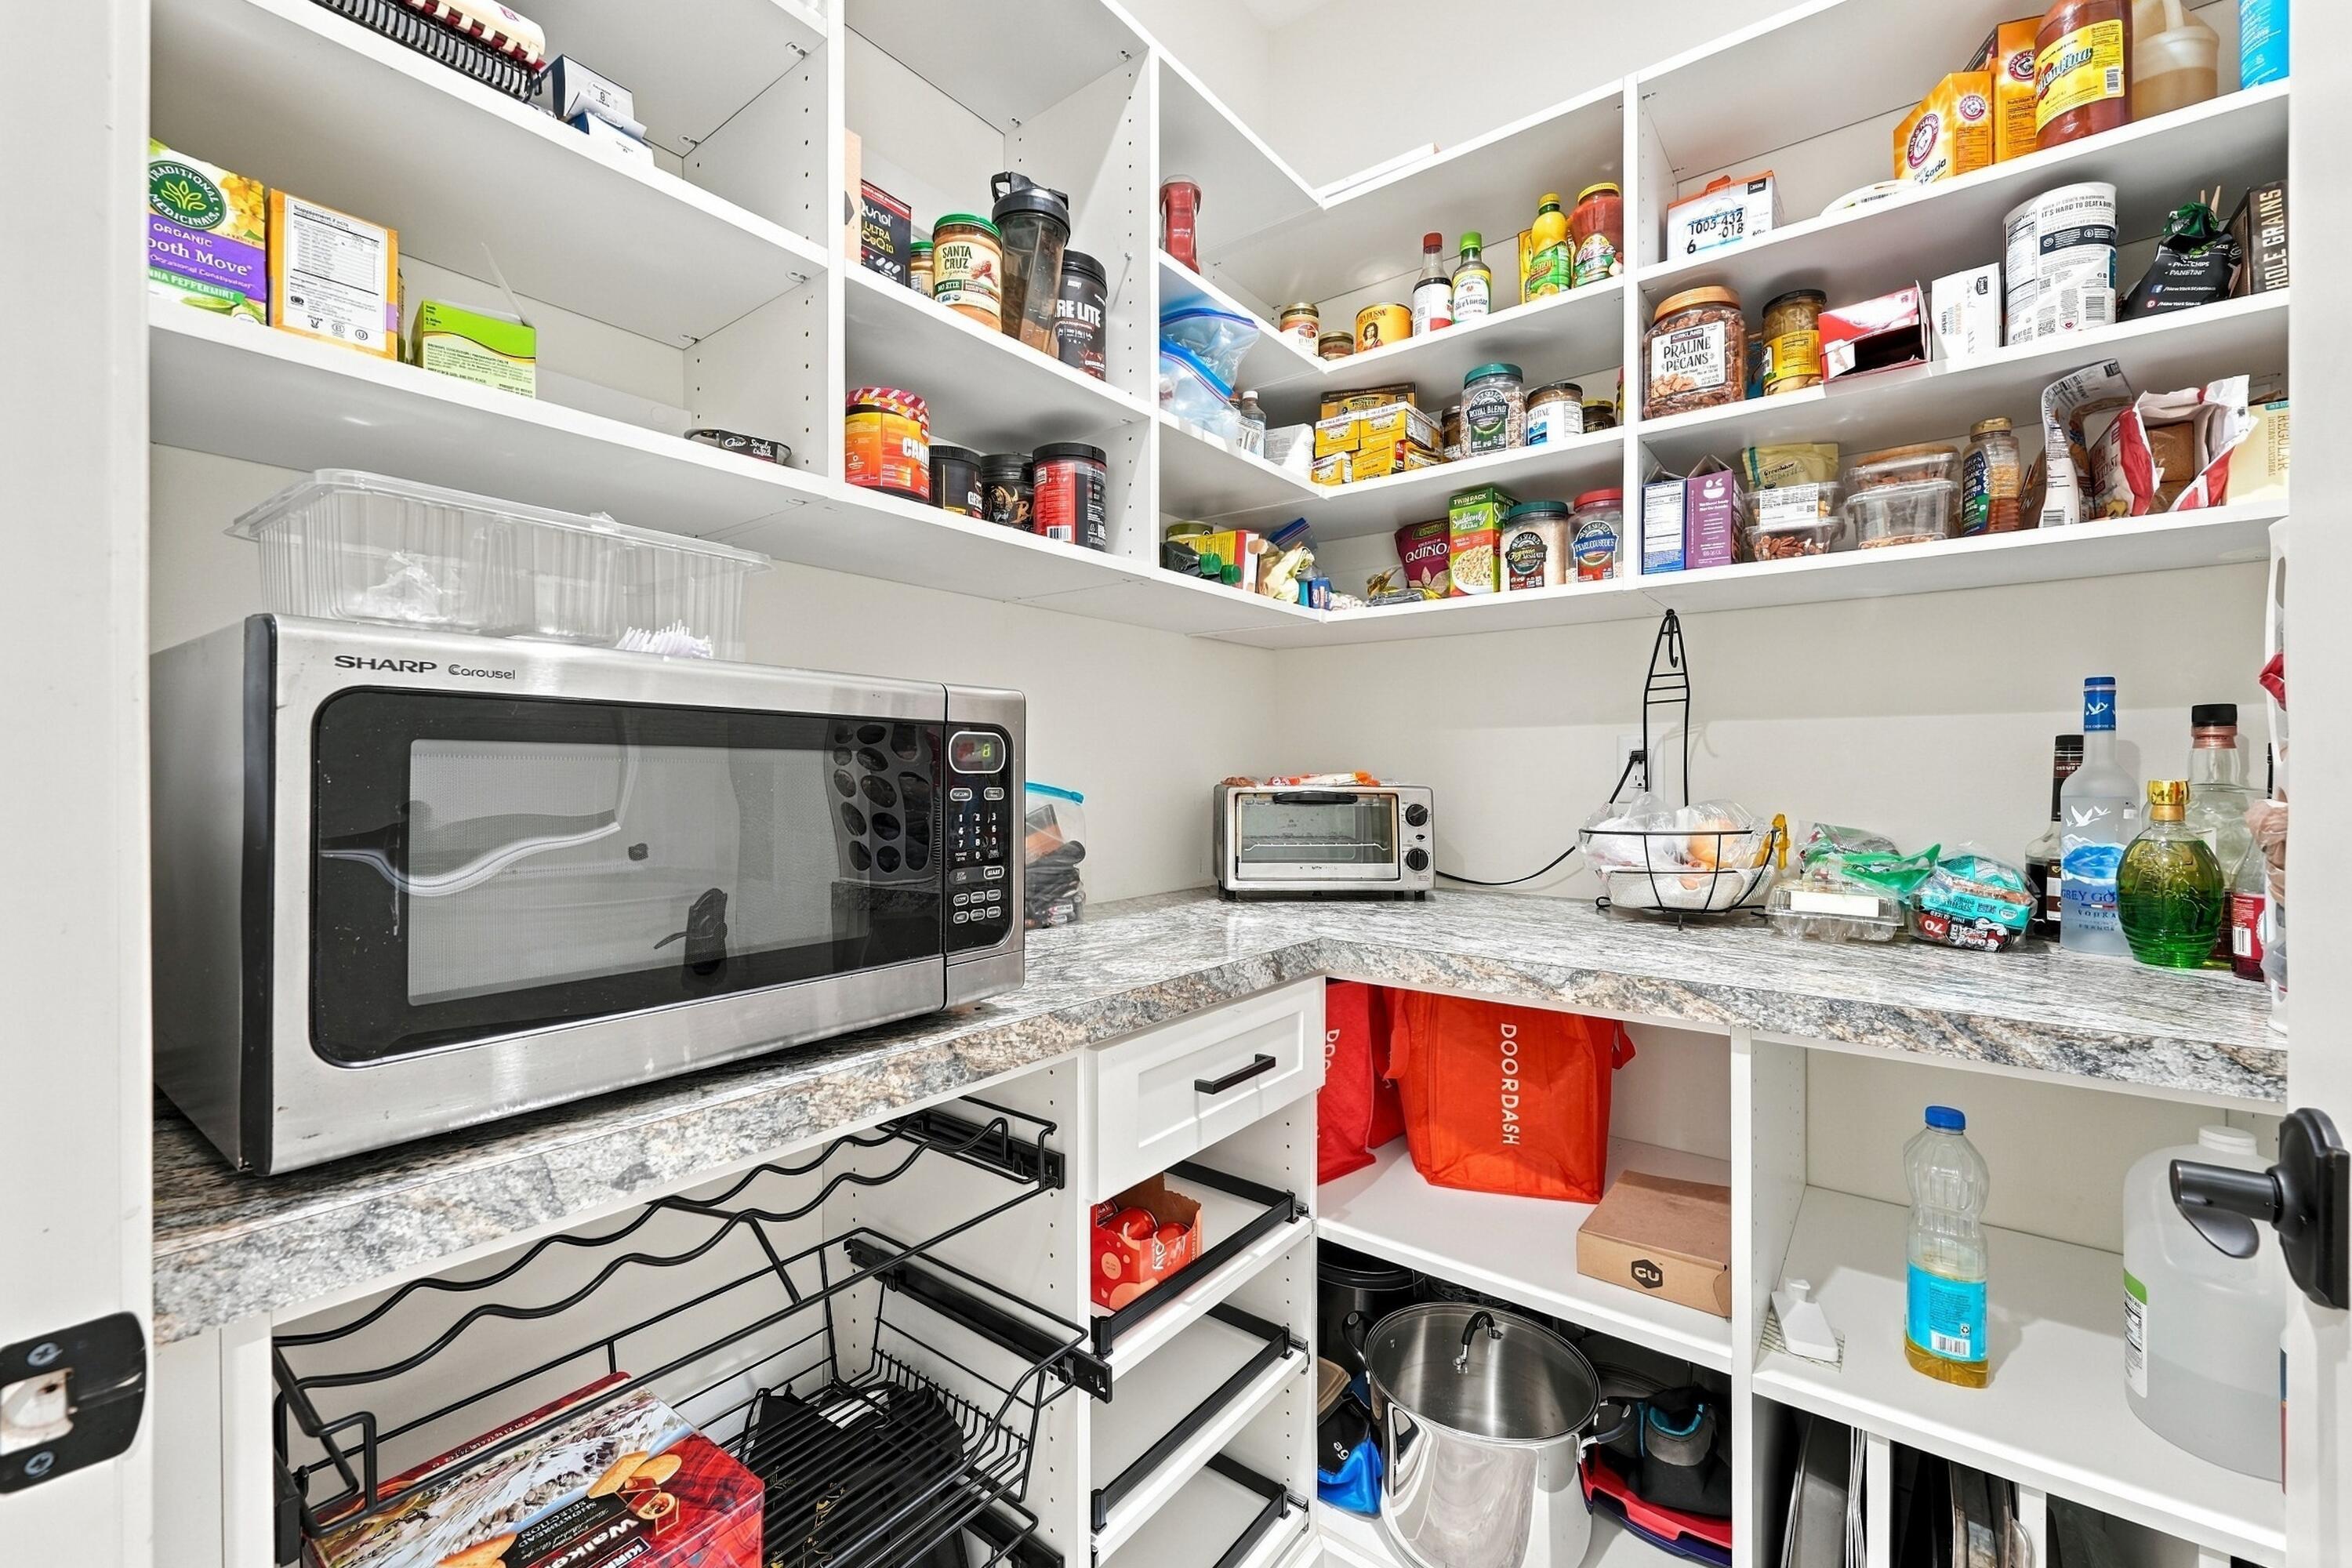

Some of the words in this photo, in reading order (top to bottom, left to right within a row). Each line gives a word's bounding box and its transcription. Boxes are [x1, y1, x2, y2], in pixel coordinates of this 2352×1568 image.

[2055, 204, 2074, 213] HARD
[2259, 188, 2286, 248] GRAINS
[153, 223, 212, 248] ORGANIC
[865, 221, 891, 241] ULTRA
[942, 245, 973, 259] SANTA
[1686, 239, 1697, 255] 6
[944, 258, 970, 270] CRUZ
[170, 272, 234, 301] PEPPERMINT
[1076, 302, 1101, 328] LITE
[1671, 328, 1703, 340] KIRKLAND
[1663, 336, 1711, 359] PRALINE
[1666, 351, 1709, 372] PECANS
[1468, 407, 1486, 418] ROYAL
[1487, 405, 1507, 415] BLEND
[1454, 496, 1470, 506] TWIN
[1470, 492, 1486, 502] PACK
[1405, 543, 1450, 564] QUINO
[334, 655, 437, 673] SHARP
[448, 664, 517, 680] Carousel
[959, 814, 964, 822] 1
[991, 812, 996, 821] 3
[958, 840, 964, 848] 7
[991, 837, 996, 845] 9
[2061, 889, 2088, 902] GREY
[1929, 910, 1951, 920] SLICED
[2078, 909, 2117, 919] VODKA
[1924, 920, 1944, 934] 70
[1500, 1023, 1521, 1145] DOORDASH
[1634, 1267, 1661, 1282] GU
[518, 1501, 598, 1549] SHORTBREAD
[521, 1500, 588, 1540] SELECTION
